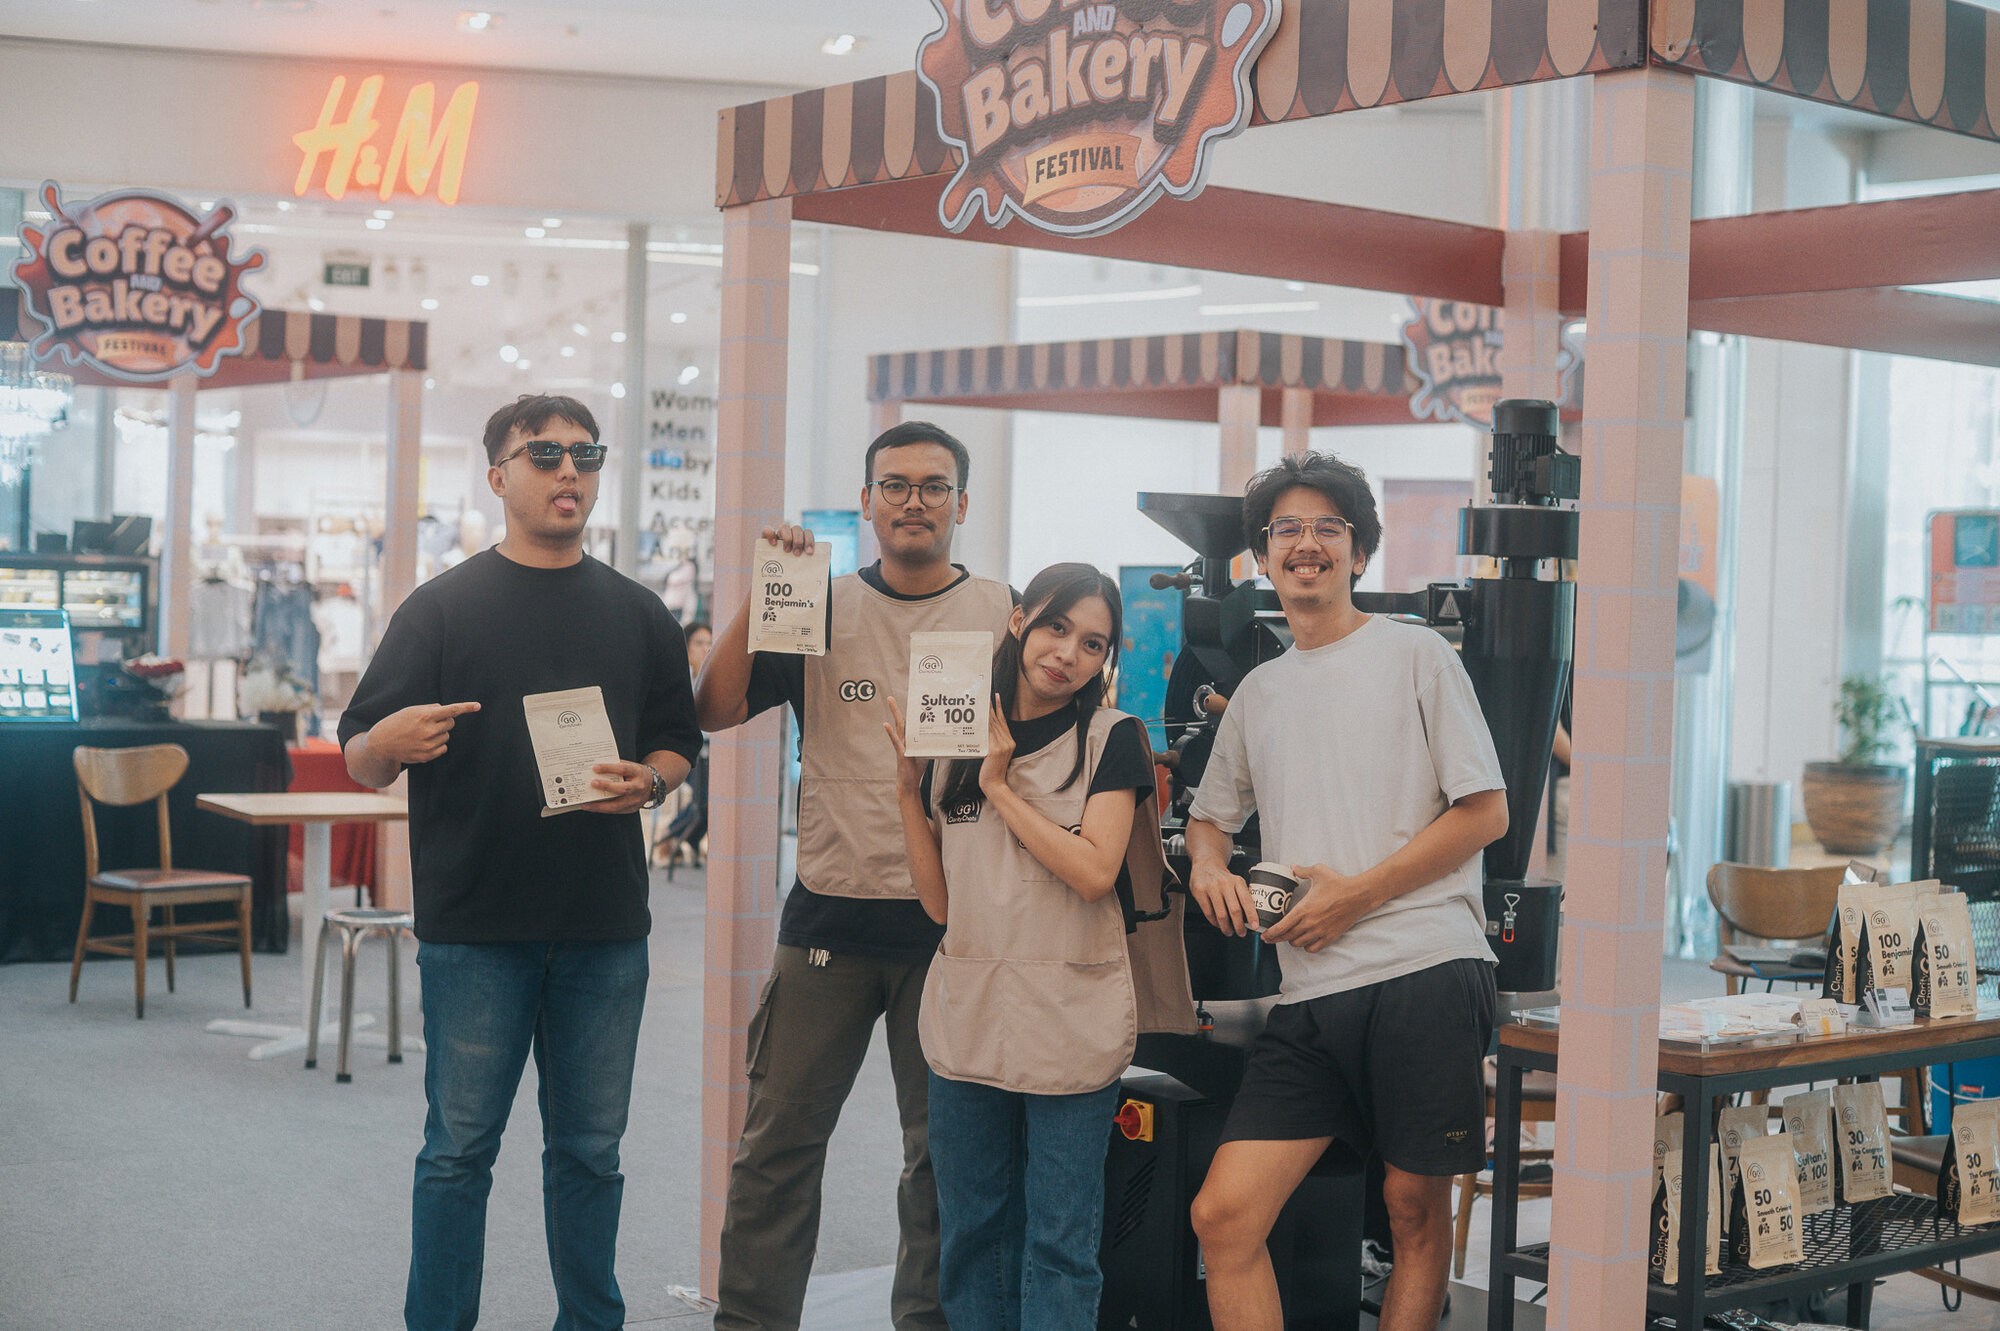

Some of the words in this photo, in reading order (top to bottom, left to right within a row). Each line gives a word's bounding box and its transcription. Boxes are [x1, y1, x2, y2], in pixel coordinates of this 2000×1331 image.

[1073, 5, 1116, 38] AND
[961, 31, 1209, 156] Bakery
[292, 75, 480, 205] H&M
[1035, 145, 1124, 183] FESTIVAL
[50, 225, 226, 292] Coffee
[48, 279, 223, 343] Bakery
[104, 338, 166, 355] FESTIVAL
[1427, 334, 1504, 386] Bak
[652, 390, 718, 410] Wom
[652, 420, 705, 439] Men
[651, 482, 700, 499] Kids
[765, 582, 792, 597] 100
[764, 597, 814, 609] Benjamin's
[921, 694, 976, 706] Sultan's
[944, 708, 975, 724] 100
[1249, 888, 1270, 899] arity
[1878, 932, 1901, 949] 100
[1934, 945, 1949, 960] 50
[1957, 971, 1969, 986] 50
[1917, 972, 1929, 1006] Clarity
[1848, 1130, 1864, 1145] 30
[1798, 1149, 1828, 1167] Sultan's
[1872, 1155, 1885, 1169] 70
[1966, 1153, 1981, 1169] 30
[1812, 1163, 1827, 1180] 100
[1755, 1189, 1771, 1207] 50
[1780, 1215, 1793, 1232] 50
[1652, 1231, 1668, 1266] Clarity
